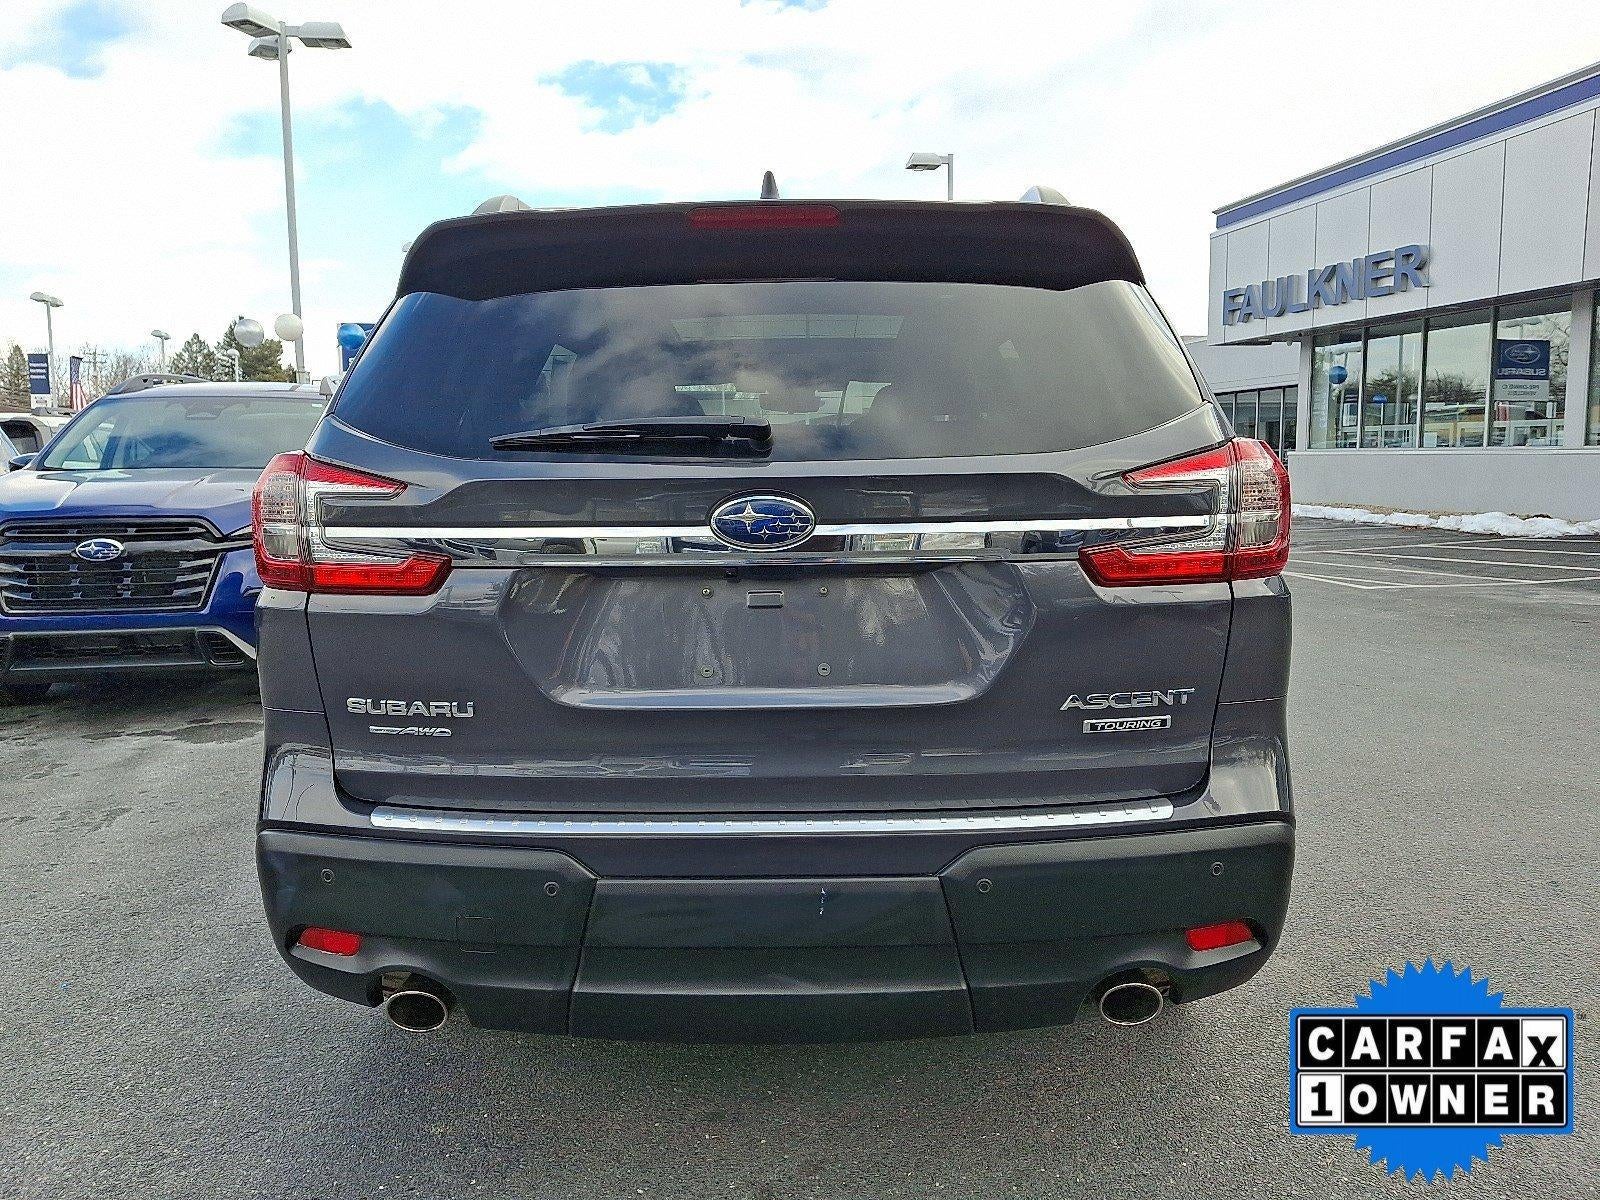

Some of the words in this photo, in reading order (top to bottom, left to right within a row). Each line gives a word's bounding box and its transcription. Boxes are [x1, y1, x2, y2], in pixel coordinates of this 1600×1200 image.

[1223, 244, 1431, 326] FAULKNER
[346, 697, 475, 718] SUBARU
[1059, 687, 1196, 711] ASCENT
[398, 726, 452, 737] AWD
[1095, 719, 1162, 731] TOURING
